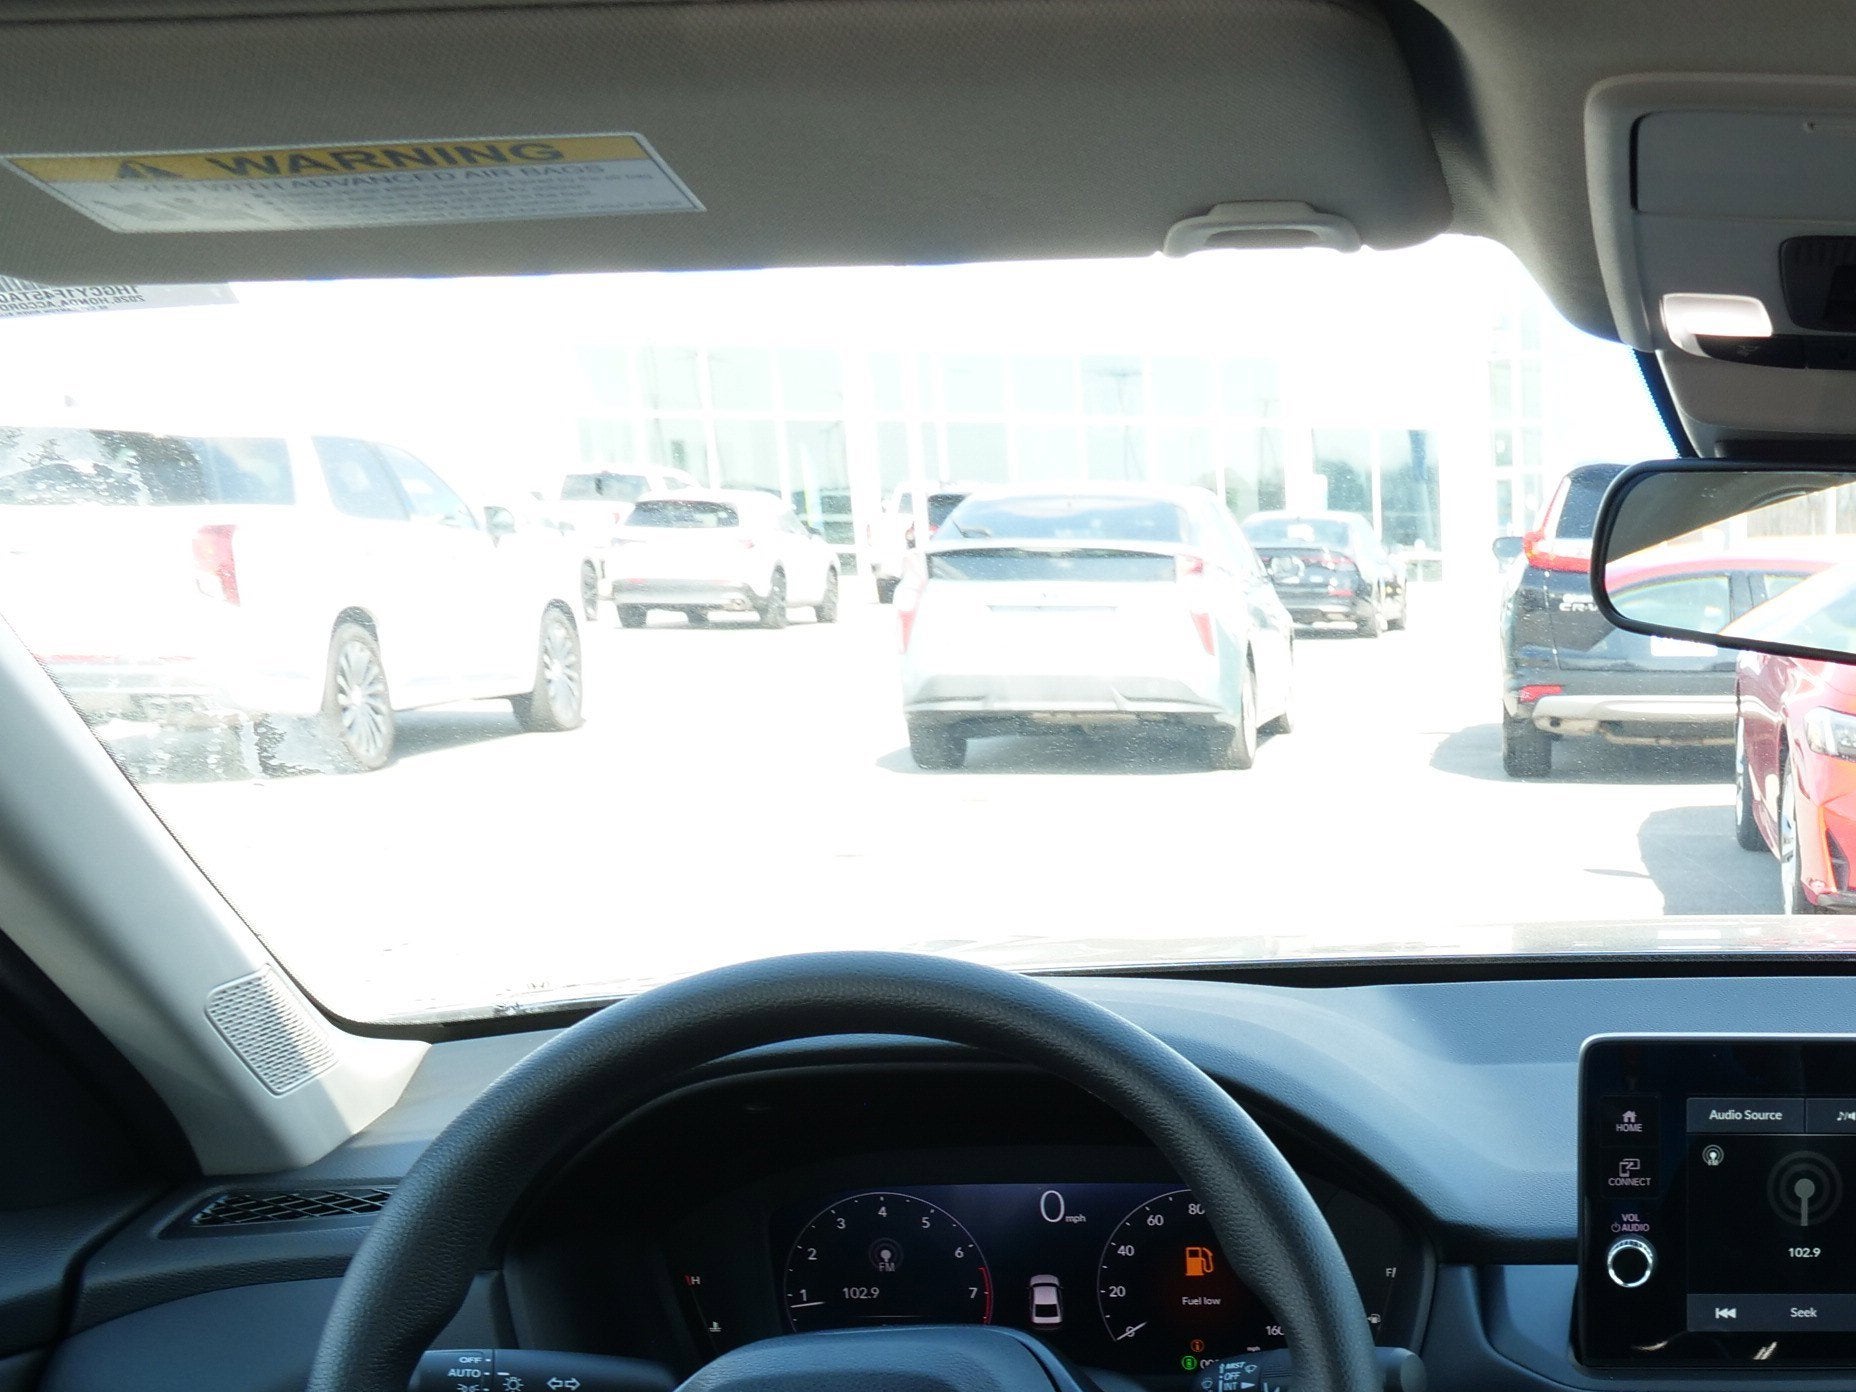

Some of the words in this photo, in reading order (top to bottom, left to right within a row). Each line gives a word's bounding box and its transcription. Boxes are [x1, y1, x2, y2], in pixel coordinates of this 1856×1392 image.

[204, 142, 564, 176] WARNING
[1709, 1109, 1743, 1121] Audio
[1745, 1110, 1783, 1121] Source
[1615, 1123, 1643, 1133] HOME
[1608, 1177, 1651, 1187] CONNECT
[878, 1206, 887, 1218] 4
[1039, 1190, 1065, 1223] 0
[1065, 1214, 1086, 1225] mph
[1188, 1203, 1205, 1215] 80
[921, 1217, 930, 1229] 5
[1146, 1215, 1164, 1226] 60
[1621, 1213, 1640, 1222] VOL
[837, 1218, 846, 1229] 3
[1621, 1223, 1650, 1232] AUDIO
[808, 1248, 818, 1260] 2
[954, 1247, 964, 1258] 6
[1117, 1245, 1135, 1256] 40
[1788, 1247, 1821, 1258] 102.9
[879, 1262, 895, 1272] FM
[691, 1276, 700, 1285] H
[800, 1290, 807, 1301] 1
[842, 1287, 880, 1299] 102.9
[968, 1287, 978, 1299] 7
[1109, 1286, 1126, 1298] 20
[1182, 1296, 1201, 1306] Fuel
[1203, 1296, 1221, 1306] low
[1790, 1307, 1817, 1318] Seek
[459, 1356, 483, 1364] OFF
[448, 1369, 482, 1378] AUTO
[1224, 1371, 1241, 1380] OFF
[1224, 1382, 1238, 1391] INT
